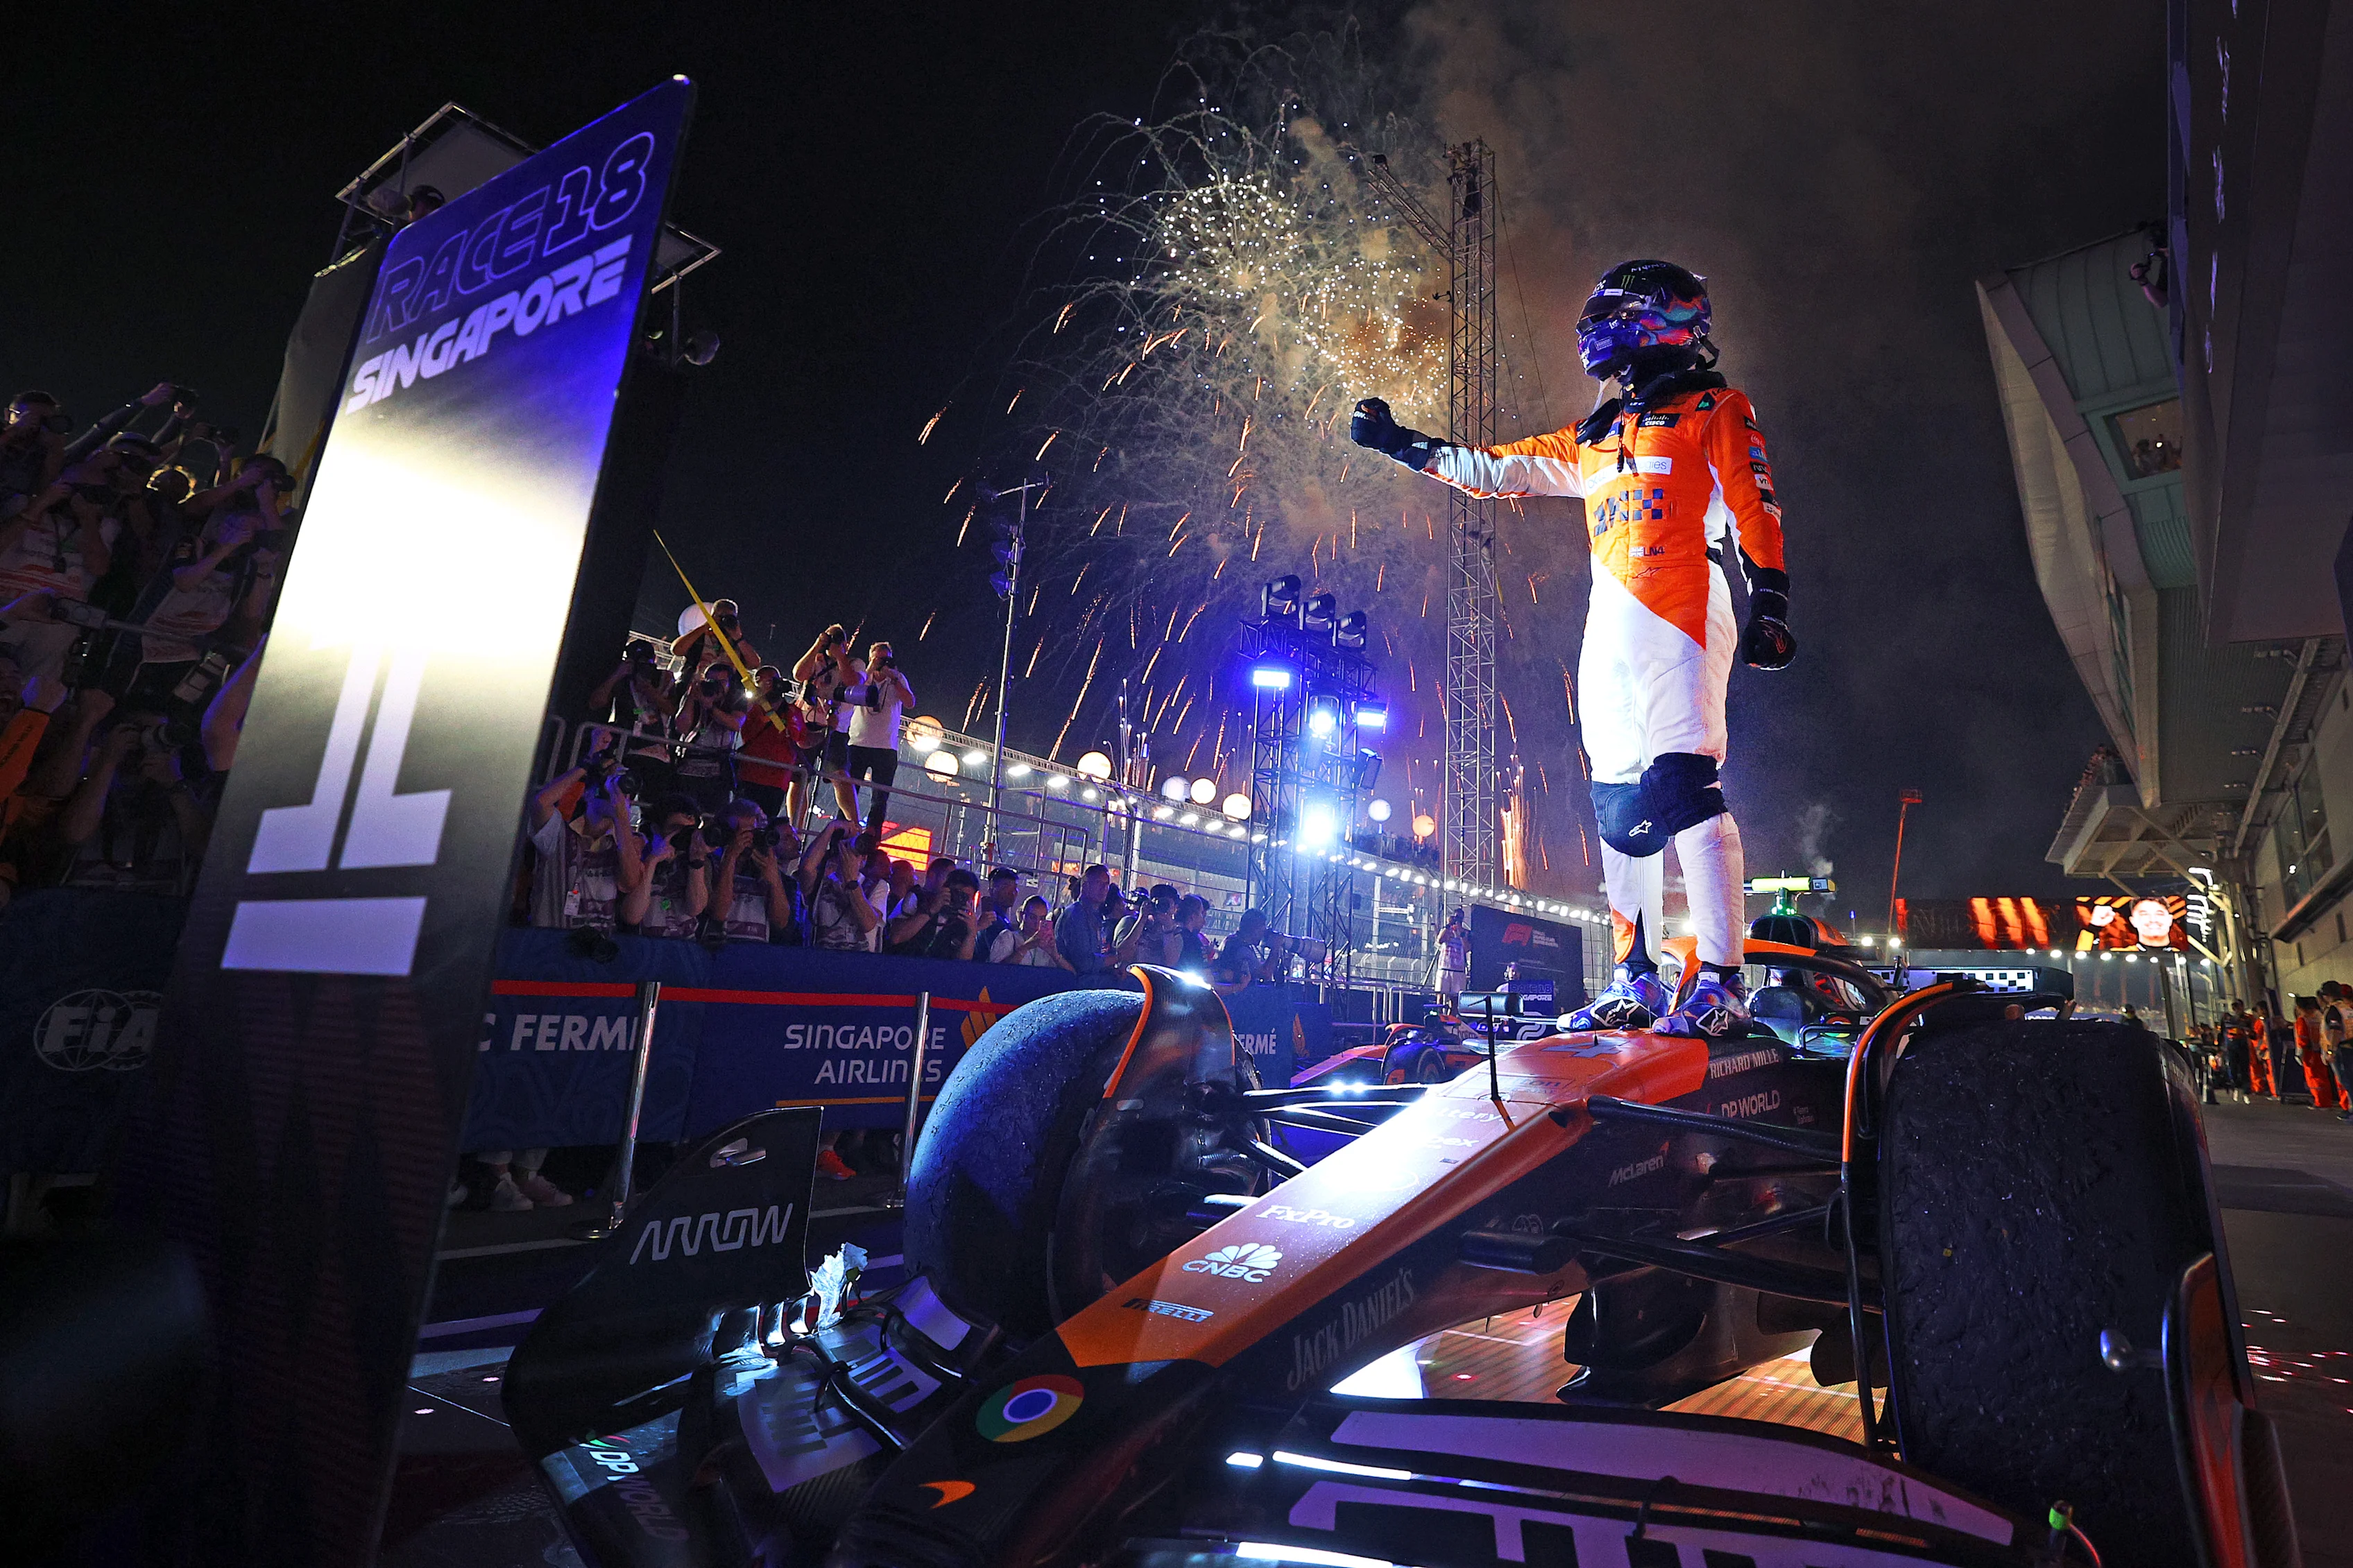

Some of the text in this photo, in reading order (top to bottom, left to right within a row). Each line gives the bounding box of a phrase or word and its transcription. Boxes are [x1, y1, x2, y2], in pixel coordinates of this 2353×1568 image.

[366, 131, 655, 344] RACE 18
[347, 234, 633, 415] SINGAPORE
[510, 1014, 638, 1051] FERM
[783, 1024, 946, 1051] SINGAPOE
[1238, 1028, 1276, 1054] ERMÉ
[814, 1059, 943, 1085] AIRLINS
[1709, 1048, 1780, 1079] RICHARD MILLE
[1738, 1089, 1781, 1118] WORLD
[1608, 1154, 1665, 1187] McLaren
[1256, 1205, 1355, 1229] FxPro
[630, 1203, 794, 1266] ARROW
[1181, 1260, 1272, 1283] CNBC
[1120, 1298, 1214, 1323] PIRELLI
[1287, 1319, 1340, 1391] JACK
